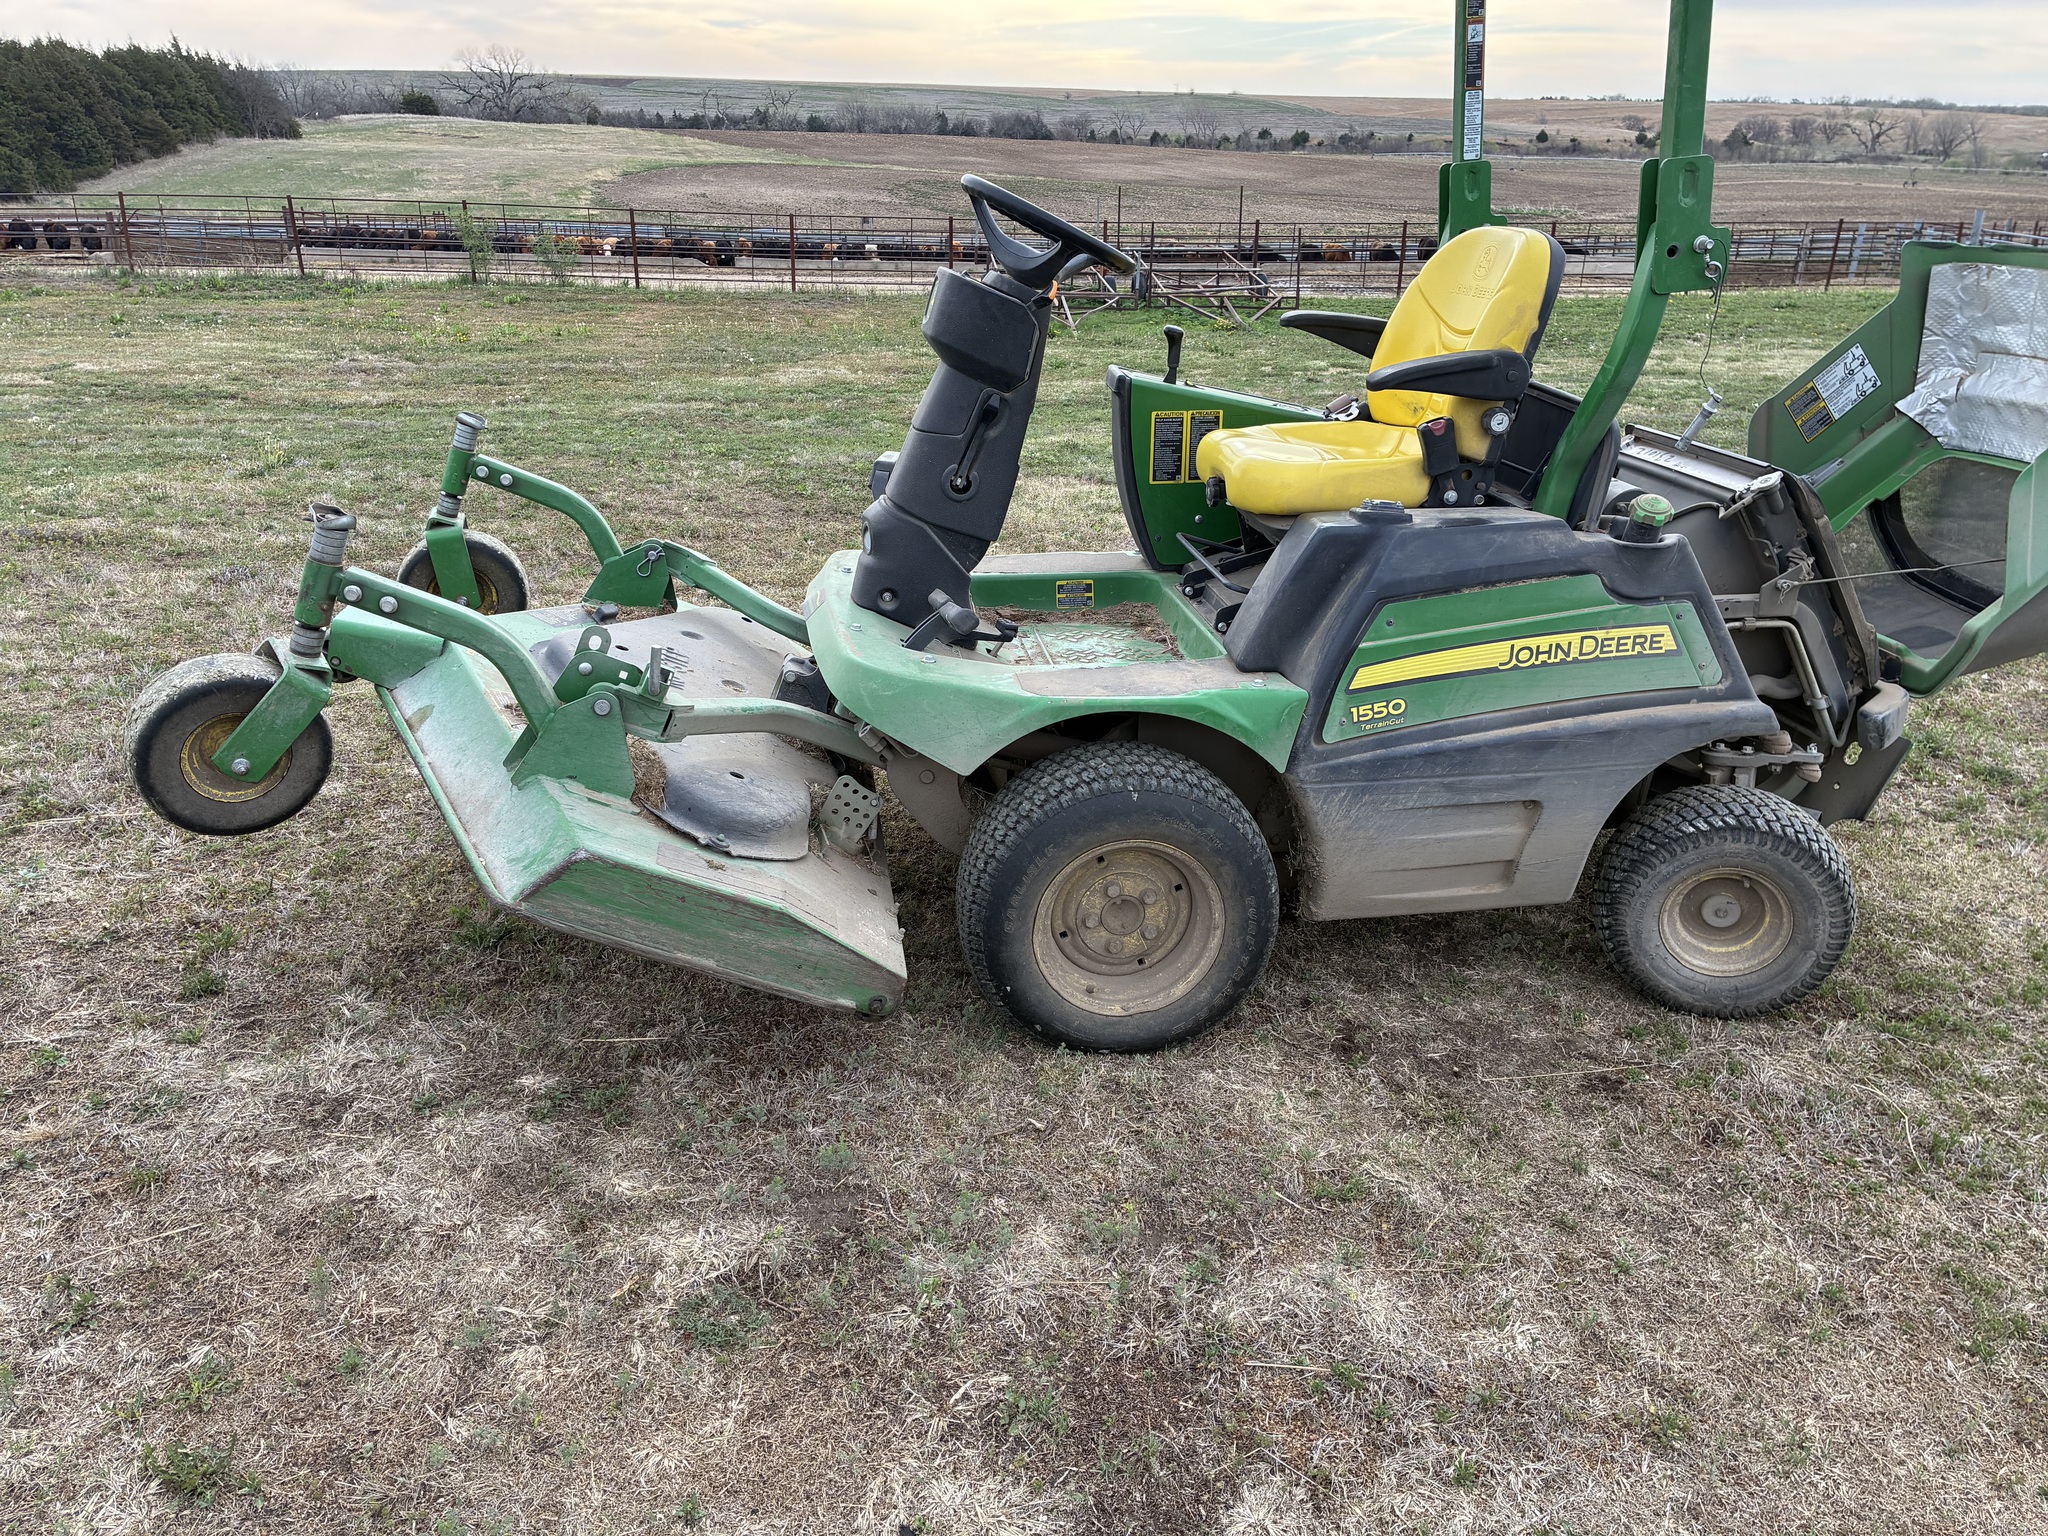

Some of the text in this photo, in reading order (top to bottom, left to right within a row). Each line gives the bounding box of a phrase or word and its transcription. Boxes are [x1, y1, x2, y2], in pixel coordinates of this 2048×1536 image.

[1450, 283, 1496, 300] JOHN DEERE
[1498, 633, 1666, 669] JOHN DEERE
[1350, 698, 1406, 723] 1550
[1360, 716, 1405, 731] TerrainCut
[1003, 843, 1057, 935] CARLISLE
